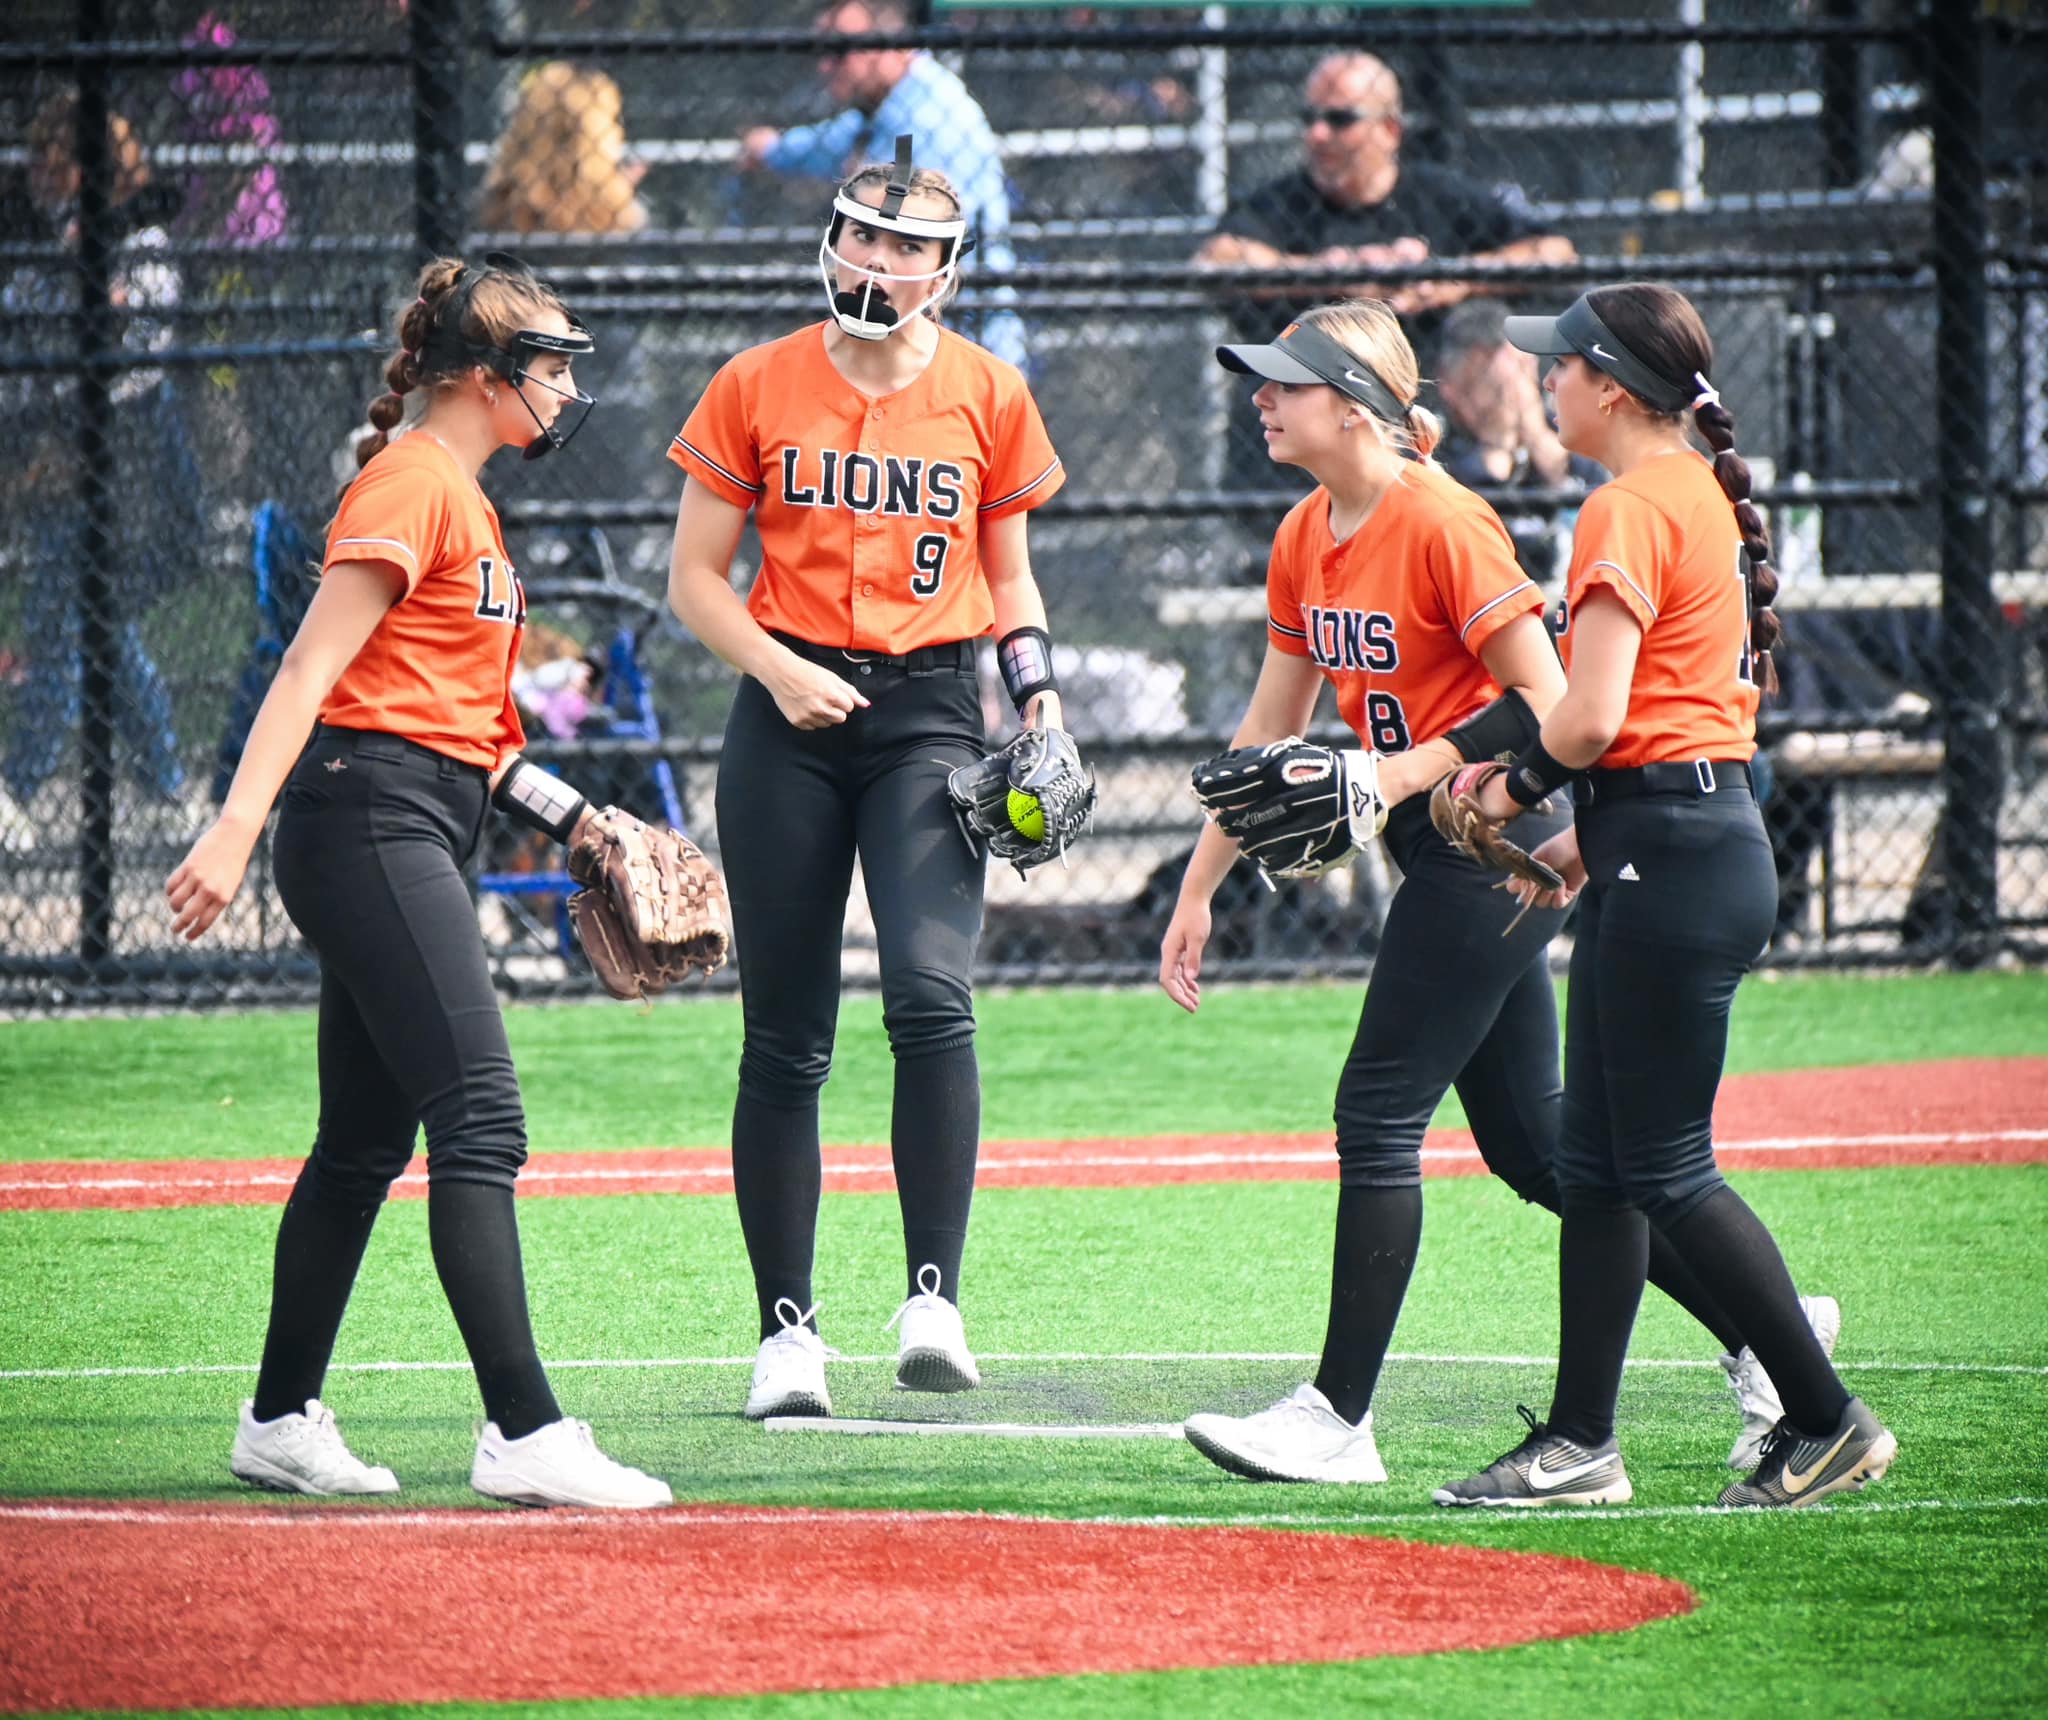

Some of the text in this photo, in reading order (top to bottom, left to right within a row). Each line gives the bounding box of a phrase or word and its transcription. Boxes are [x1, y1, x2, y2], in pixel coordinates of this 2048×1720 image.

[783, 447, 963, 520] LIONS
[911, 532, 949, 597] 9
[1365, 689, 1412, 756] 8
